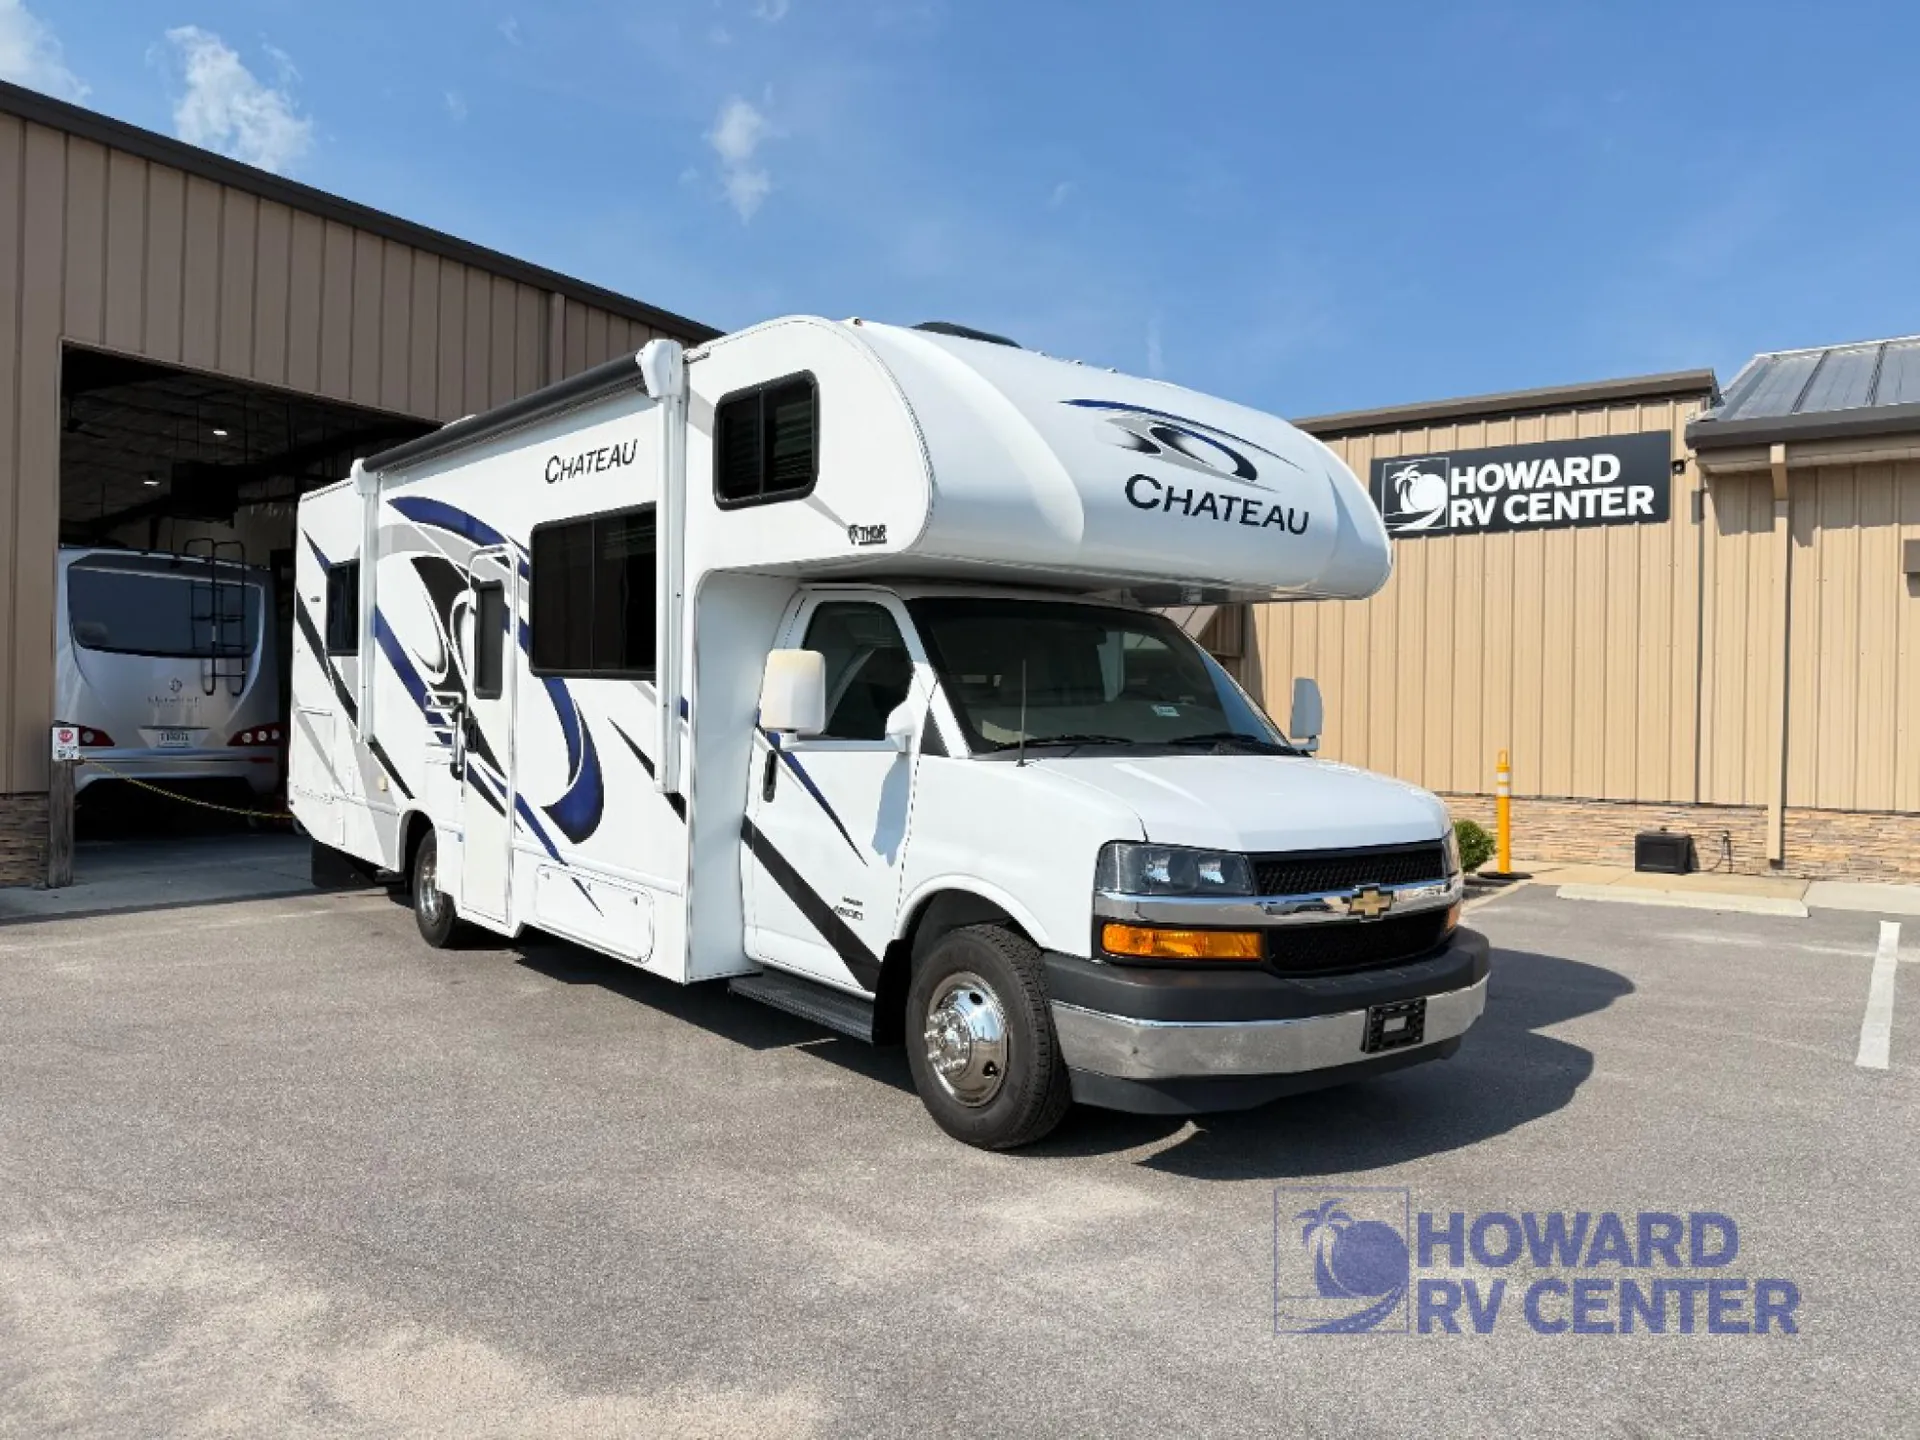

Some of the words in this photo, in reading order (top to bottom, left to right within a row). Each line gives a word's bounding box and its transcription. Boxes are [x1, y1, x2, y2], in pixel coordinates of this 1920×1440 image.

[545, 438, 638, 484] CHATEAU
[1451, 453, 1621, 496] HOWARD
[1125, 473, 1310, 535] CHATEAU
[1451, 497, 1496, 528] RV
[1503, 485, 1655, 524] CENTER
[858, 524, 886, 540] THOR
